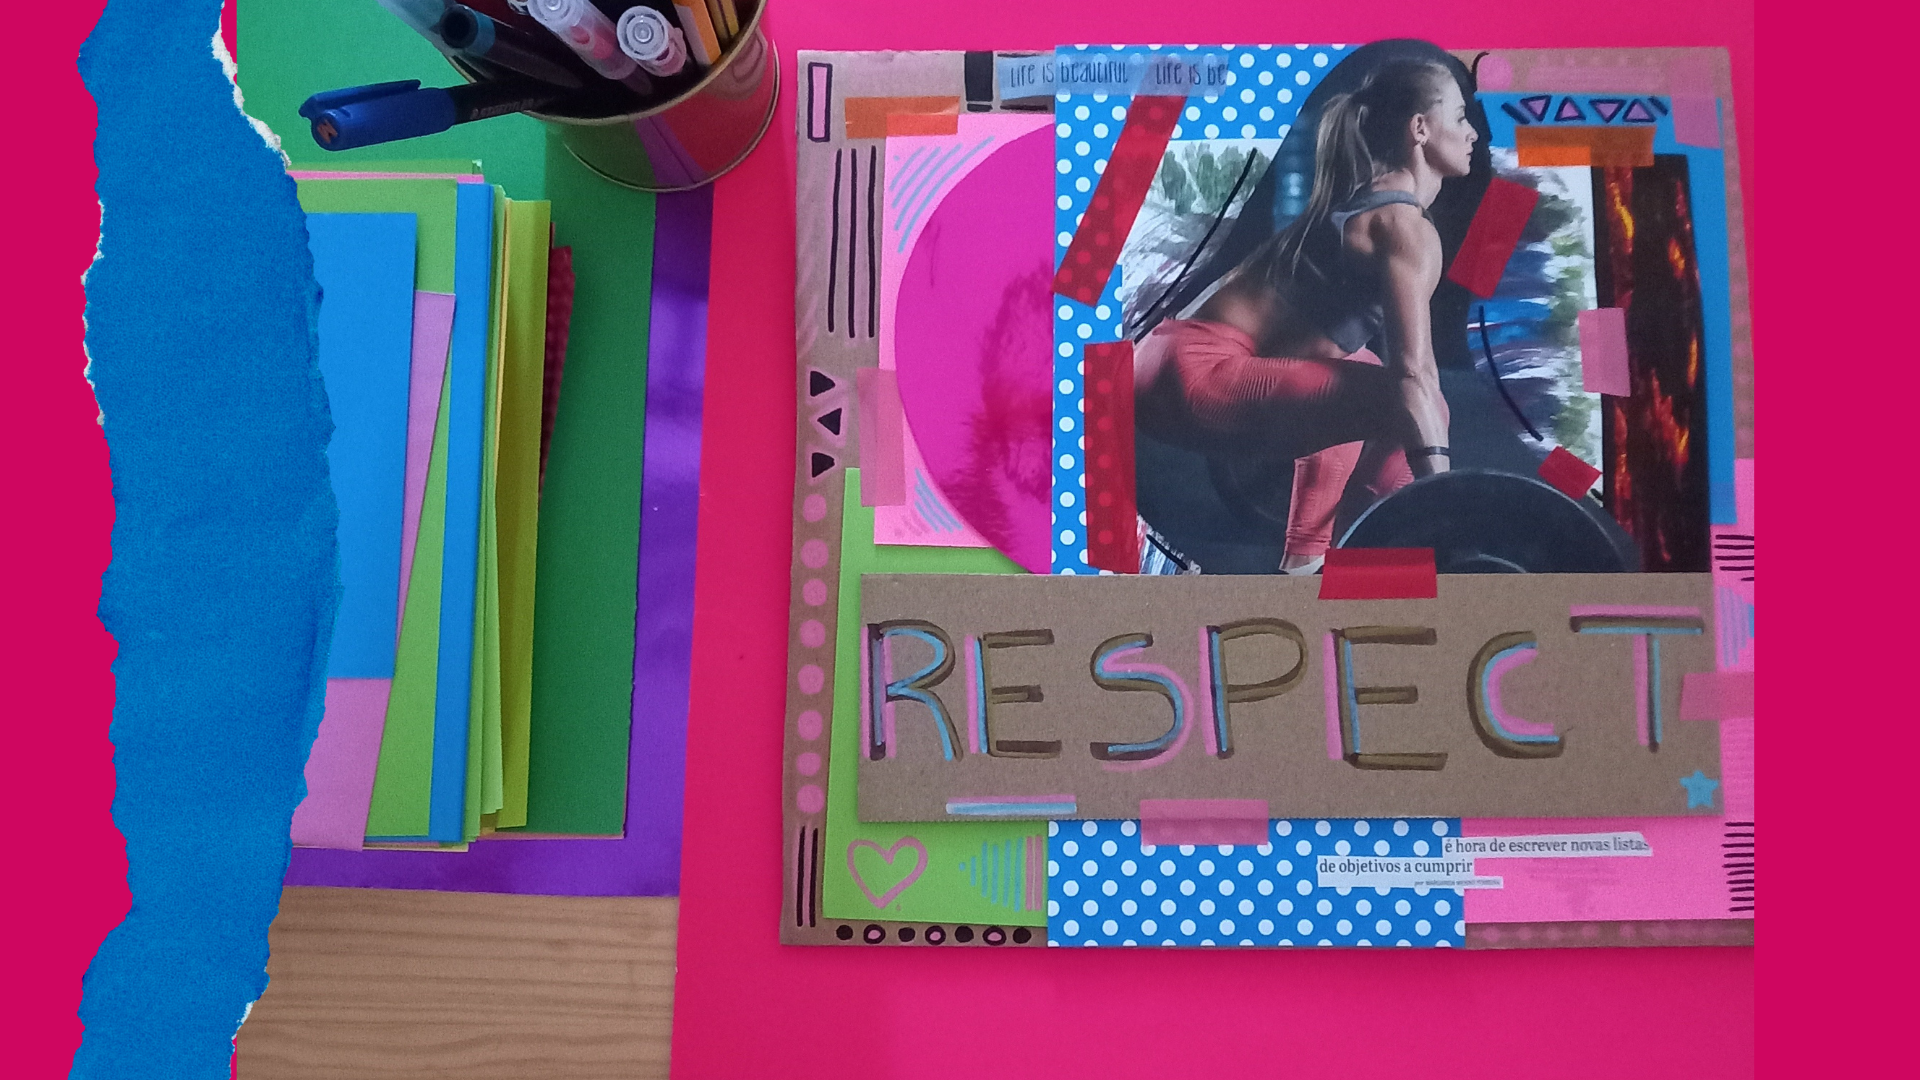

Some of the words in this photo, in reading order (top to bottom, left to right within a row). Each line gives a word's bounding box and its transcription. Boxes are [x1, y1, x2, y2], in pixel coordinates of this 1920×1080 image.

[1060, 61, 1129, 83] beautiful
[862, 605, 1703, 771] RESPECT
[1444, 839, 1452, 853] é
[1456, 838, 1486, 853] hora
[1489, 838, 1506, 853] de
[1508, 841, 1567, 853] escrever
[1570, 840, 1609, 852] novas
[1319, 858, 1336, 873] de
[1338, 858, 1401, 876] objetivos
[1403, 862, 1412, 873] a
[1414, 858, 1473, 876] cumprir
